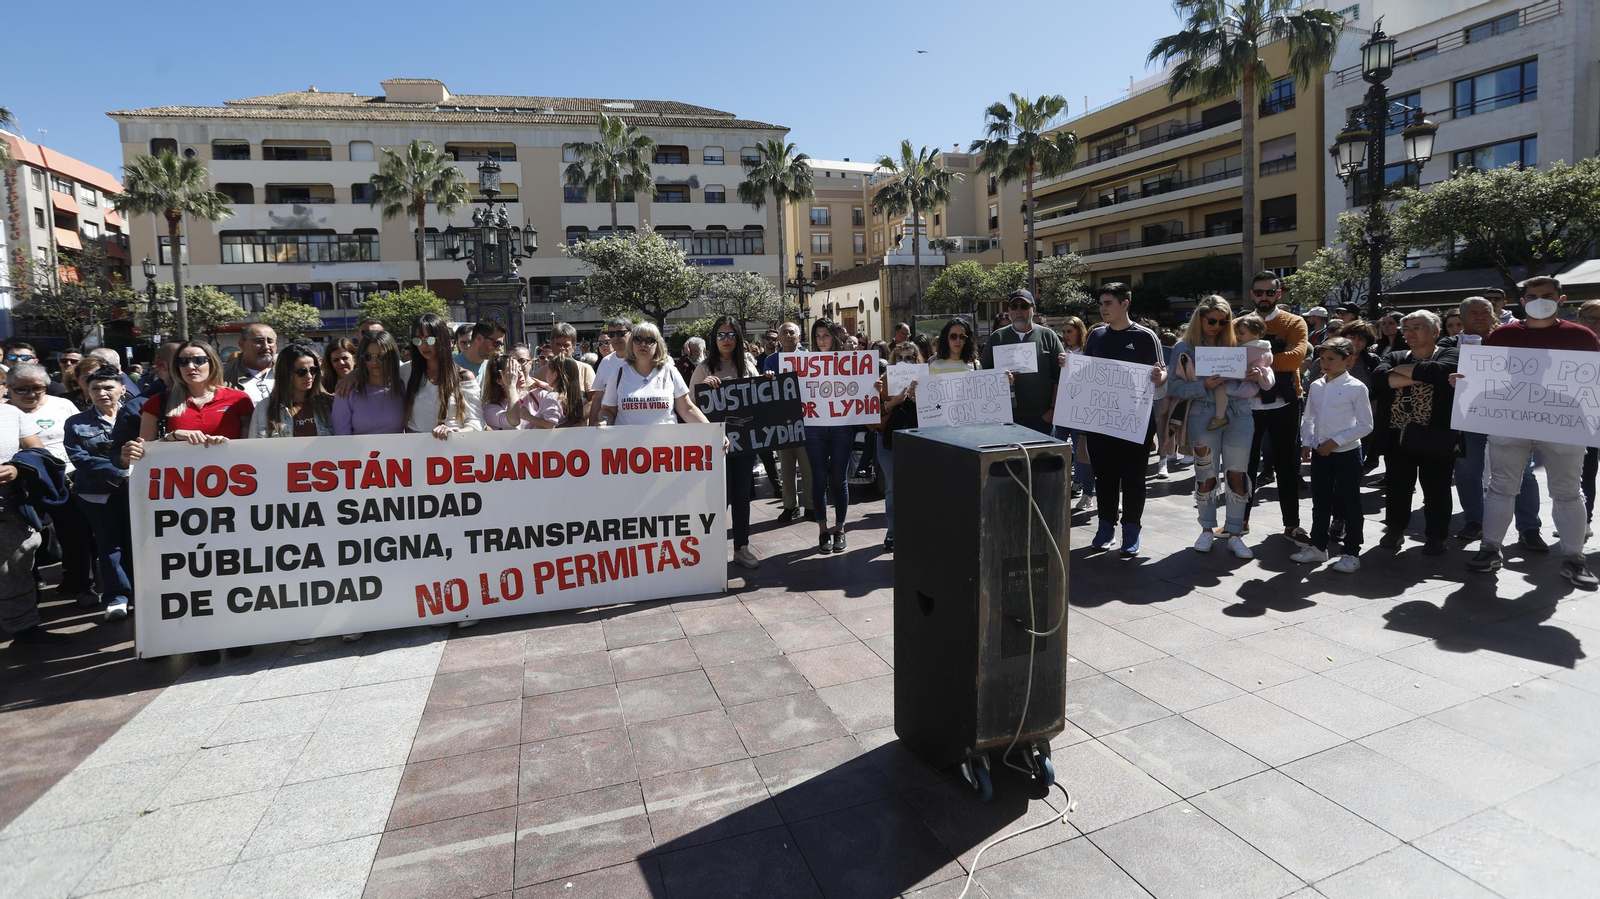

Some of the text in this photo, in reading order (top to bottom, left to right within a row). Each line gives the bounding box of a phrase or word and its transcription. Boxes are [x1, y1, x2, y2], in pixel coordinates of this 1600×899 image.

[7, 168, 24, 238] EDIFICIO
[1470, 354, 1539, 376] TODO
[805, 381, 859, 398] TODO
[926, 373, 1009, 404] SIEMPRE
[1090, 389, 1120, 410] POR
[1484, 379, 1599, 408] LYDIA
[621, 401, 670, 411] CUESTA VIDAS
[947, 401, 978, 426] CON
[1070, 405, 1138, 434] LYDIA
[1468, 405, 1586, 428] #JUSTICIAPORLYDIA
[148, 445, 712, 500] ¡NOS ESTÁN DEJANDO MORIR!
[154, 491, 483, 538] POR UNA SANIDAD
[161, 513, 716, 581] PÚBLICA DIGNA, TRANSPARENTE Y
[414, 536, 701, 618] NO LO PERMITAS
[160, 575, 383, 620] DE CALIDAD
